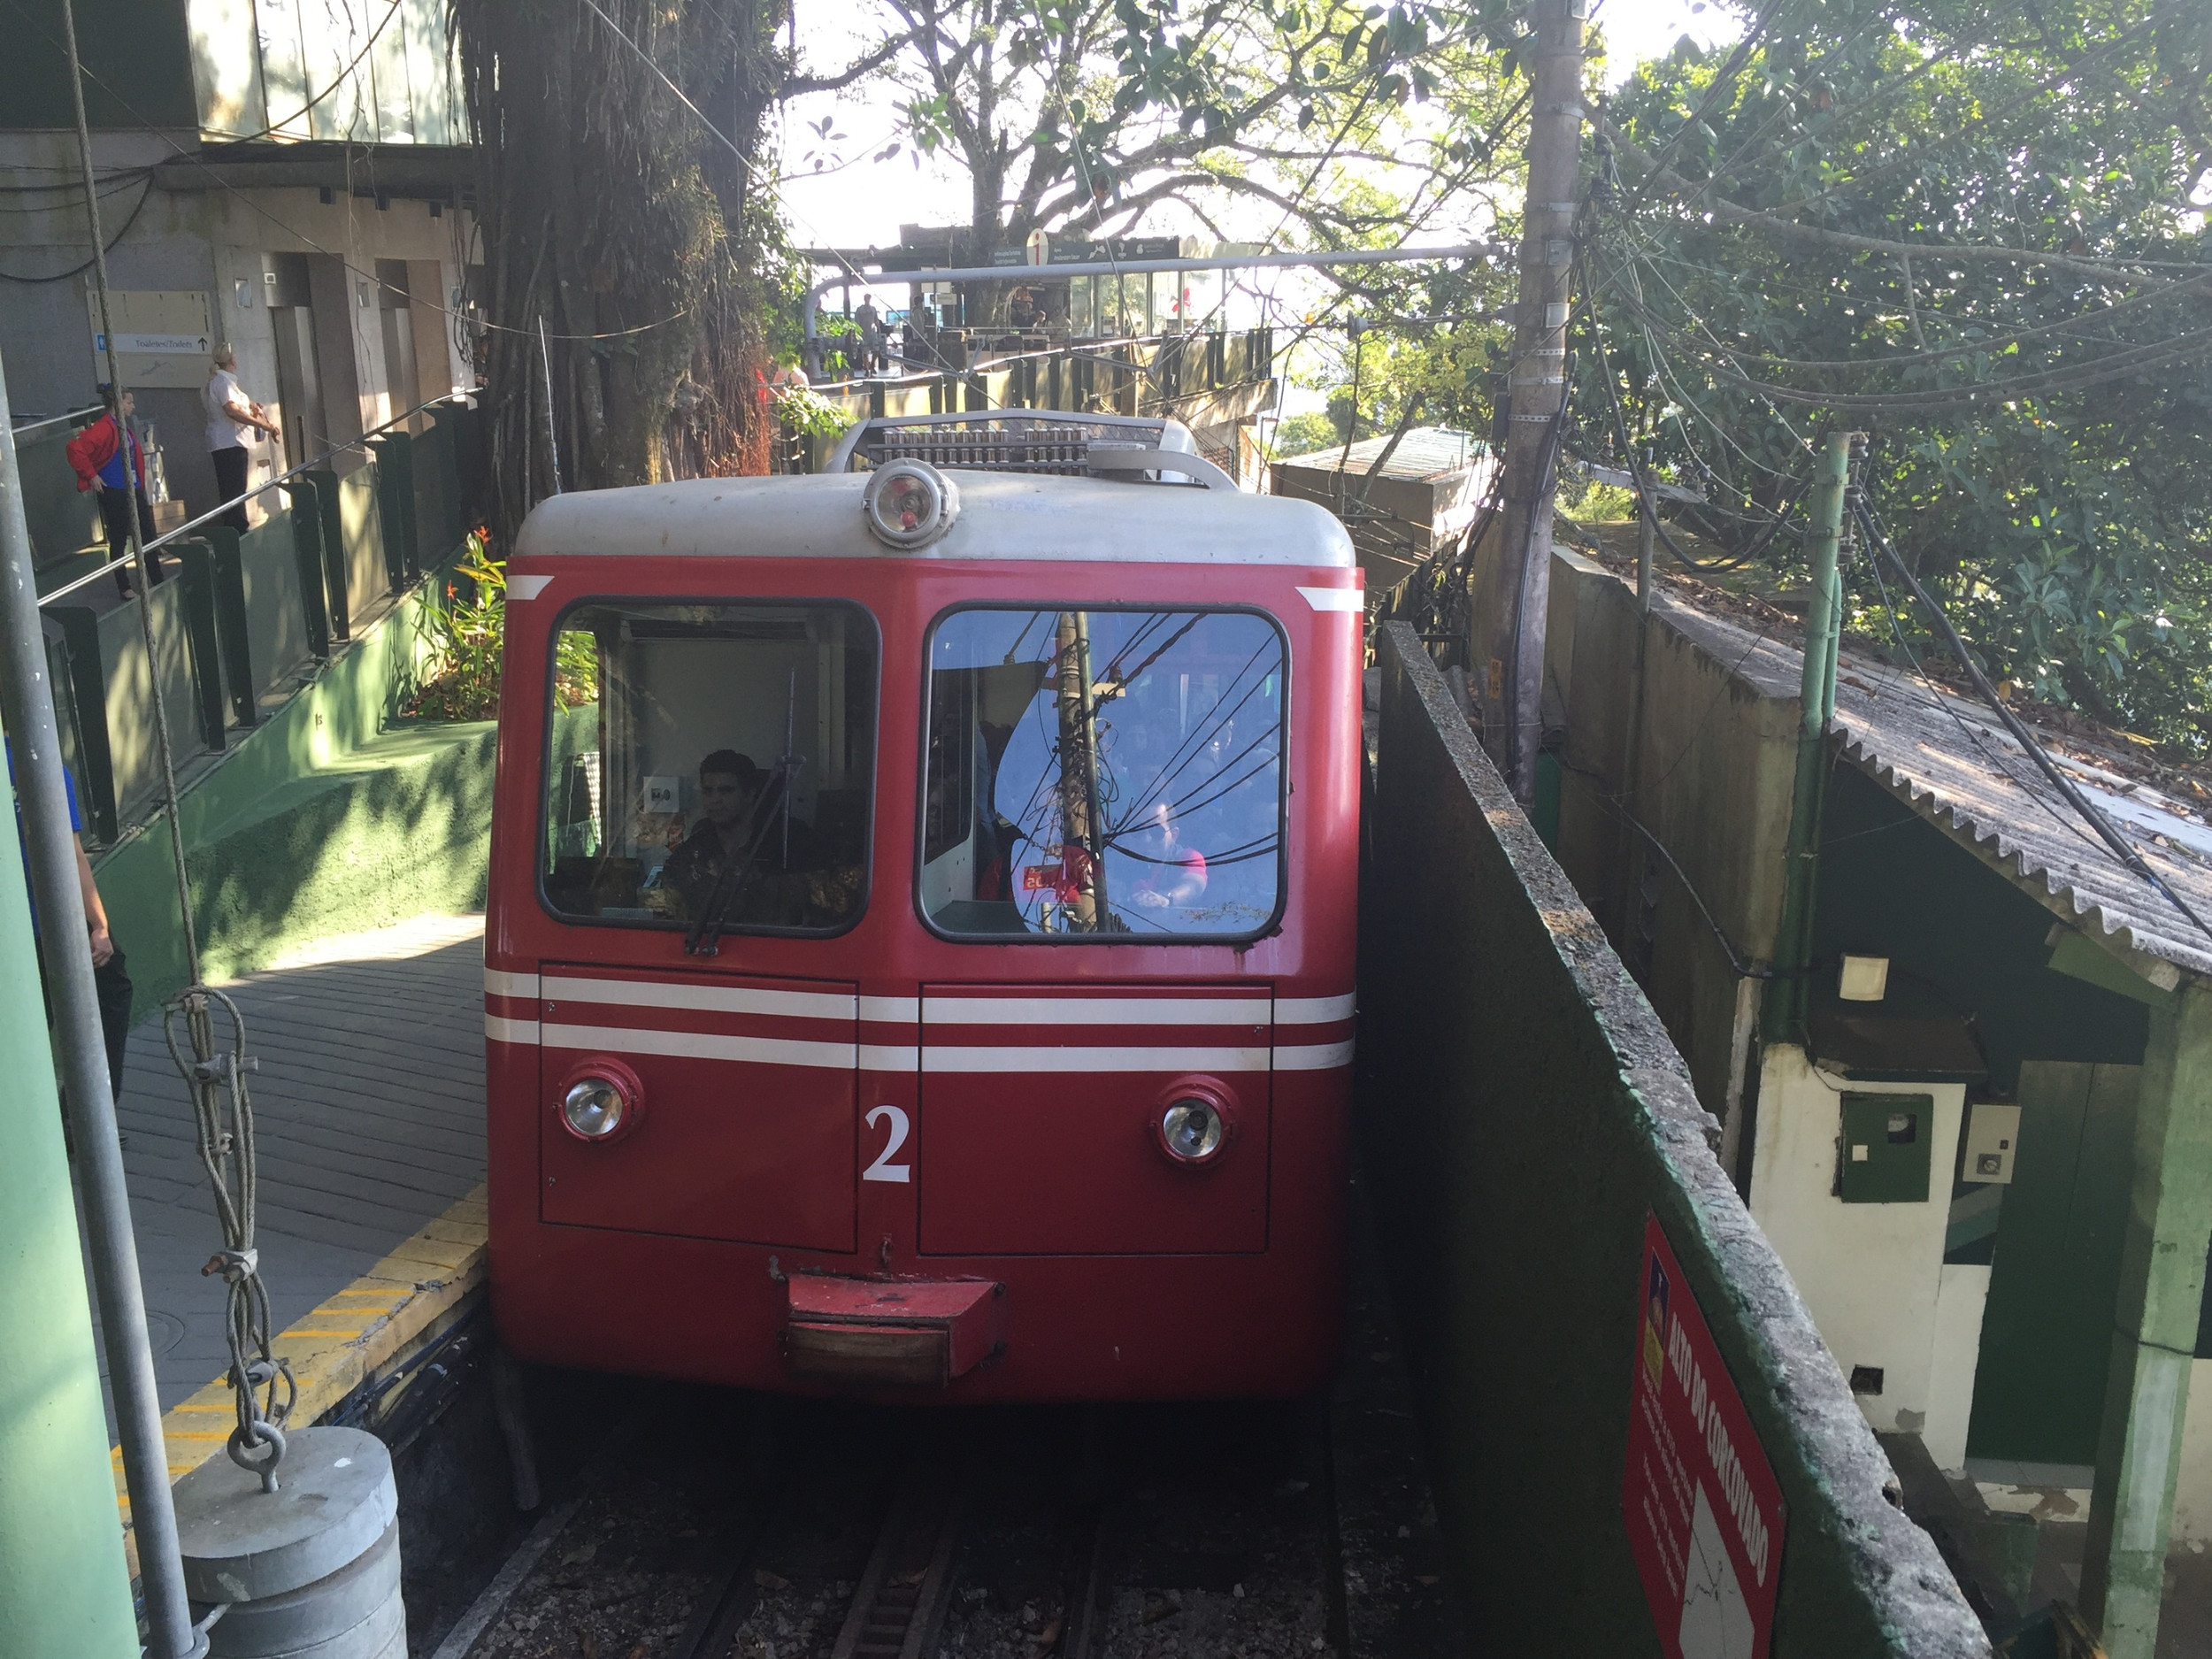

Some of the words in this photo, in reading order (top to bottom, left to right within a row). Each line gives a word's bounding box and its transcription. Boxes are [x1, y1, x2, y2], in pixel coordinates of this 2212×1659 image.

[863, 1105, 910, 1183] 2
[1669, 1311, 1692, 1397] ALTO
[1692, 1361, 1707, 1434] DO
[1707, 1401, 1768, 1587] CORCOVADO
